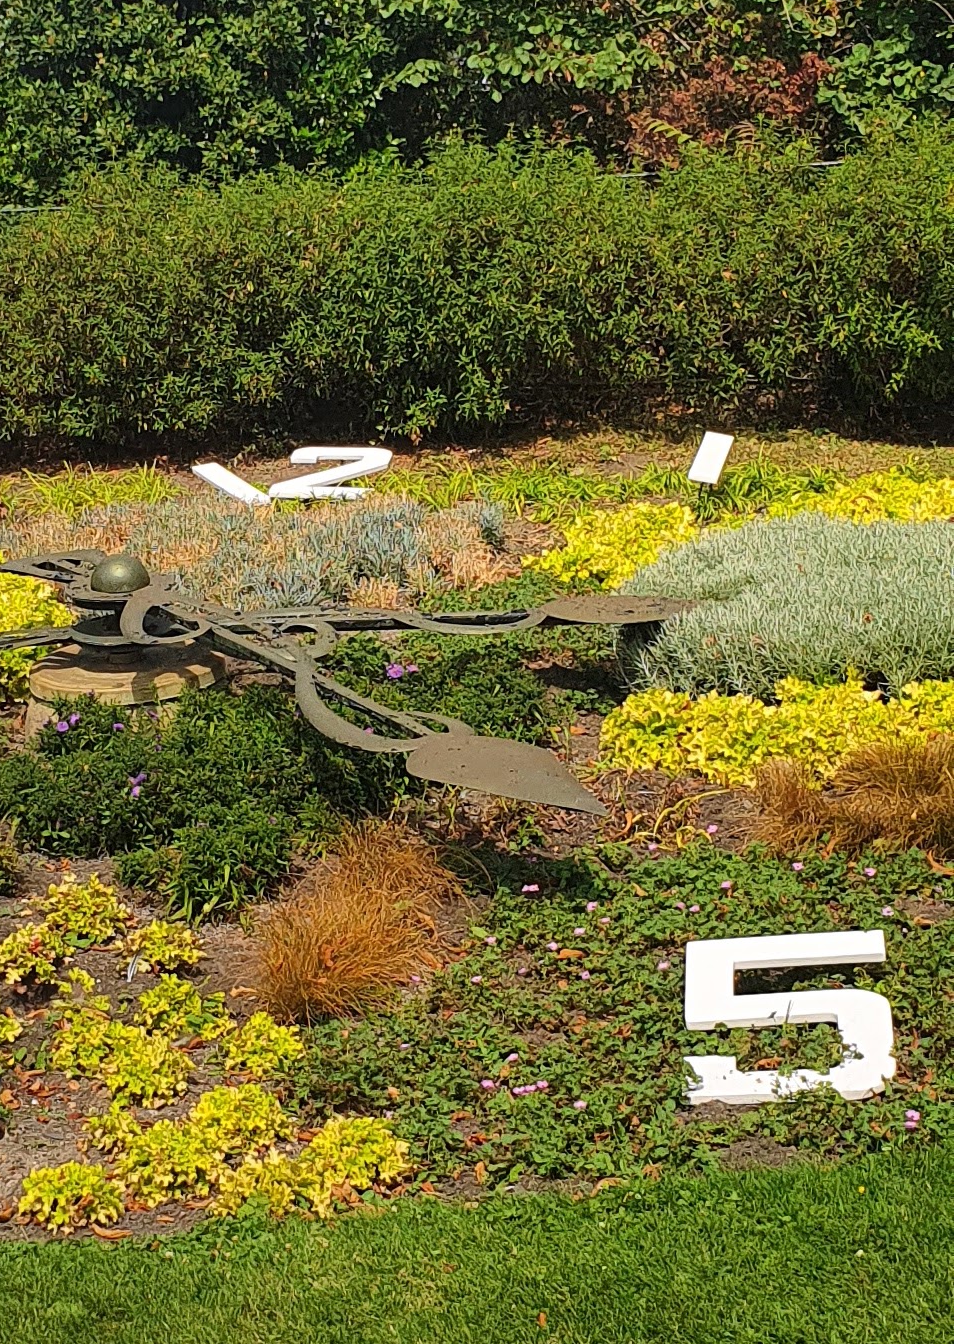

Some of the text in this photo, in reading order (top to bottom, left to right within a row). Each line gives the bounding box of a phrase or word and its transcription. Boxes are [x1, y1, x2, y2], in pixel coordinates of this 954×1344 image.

[192, 446, 393, 504] 12
[688, 431, 734, 484] 1
[683, 929, 897, 1106] 5
